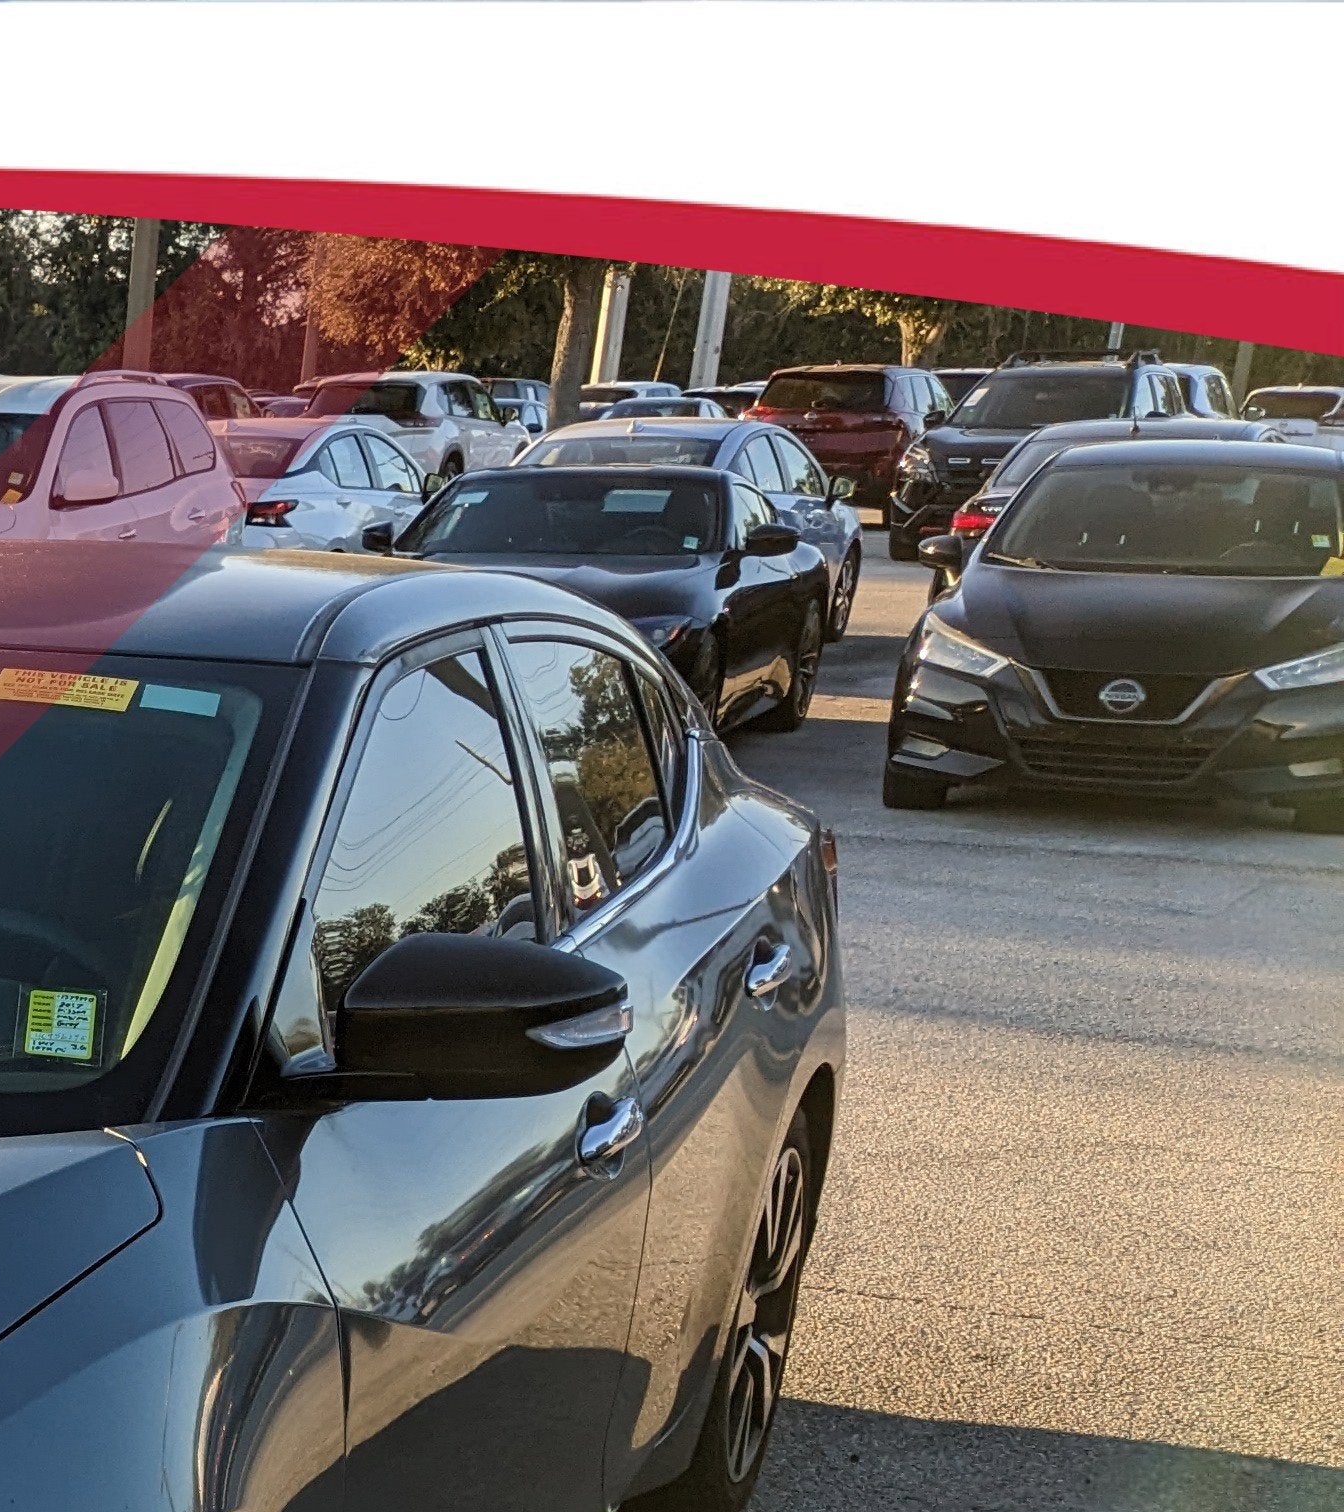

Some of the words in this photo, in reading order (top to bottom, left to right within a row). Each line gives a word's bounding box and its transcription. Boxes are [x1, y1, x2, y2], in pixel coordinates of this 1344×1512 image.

[14, 670, 46, 678] THIS
[50, 673, 110, 685] VEHICLE
[114, 679, 128, 687] IS
[15, 676, 44, 684] NOT
[50, 679, 77, 688] FOR
[81, 683, 119, 692] SALE
